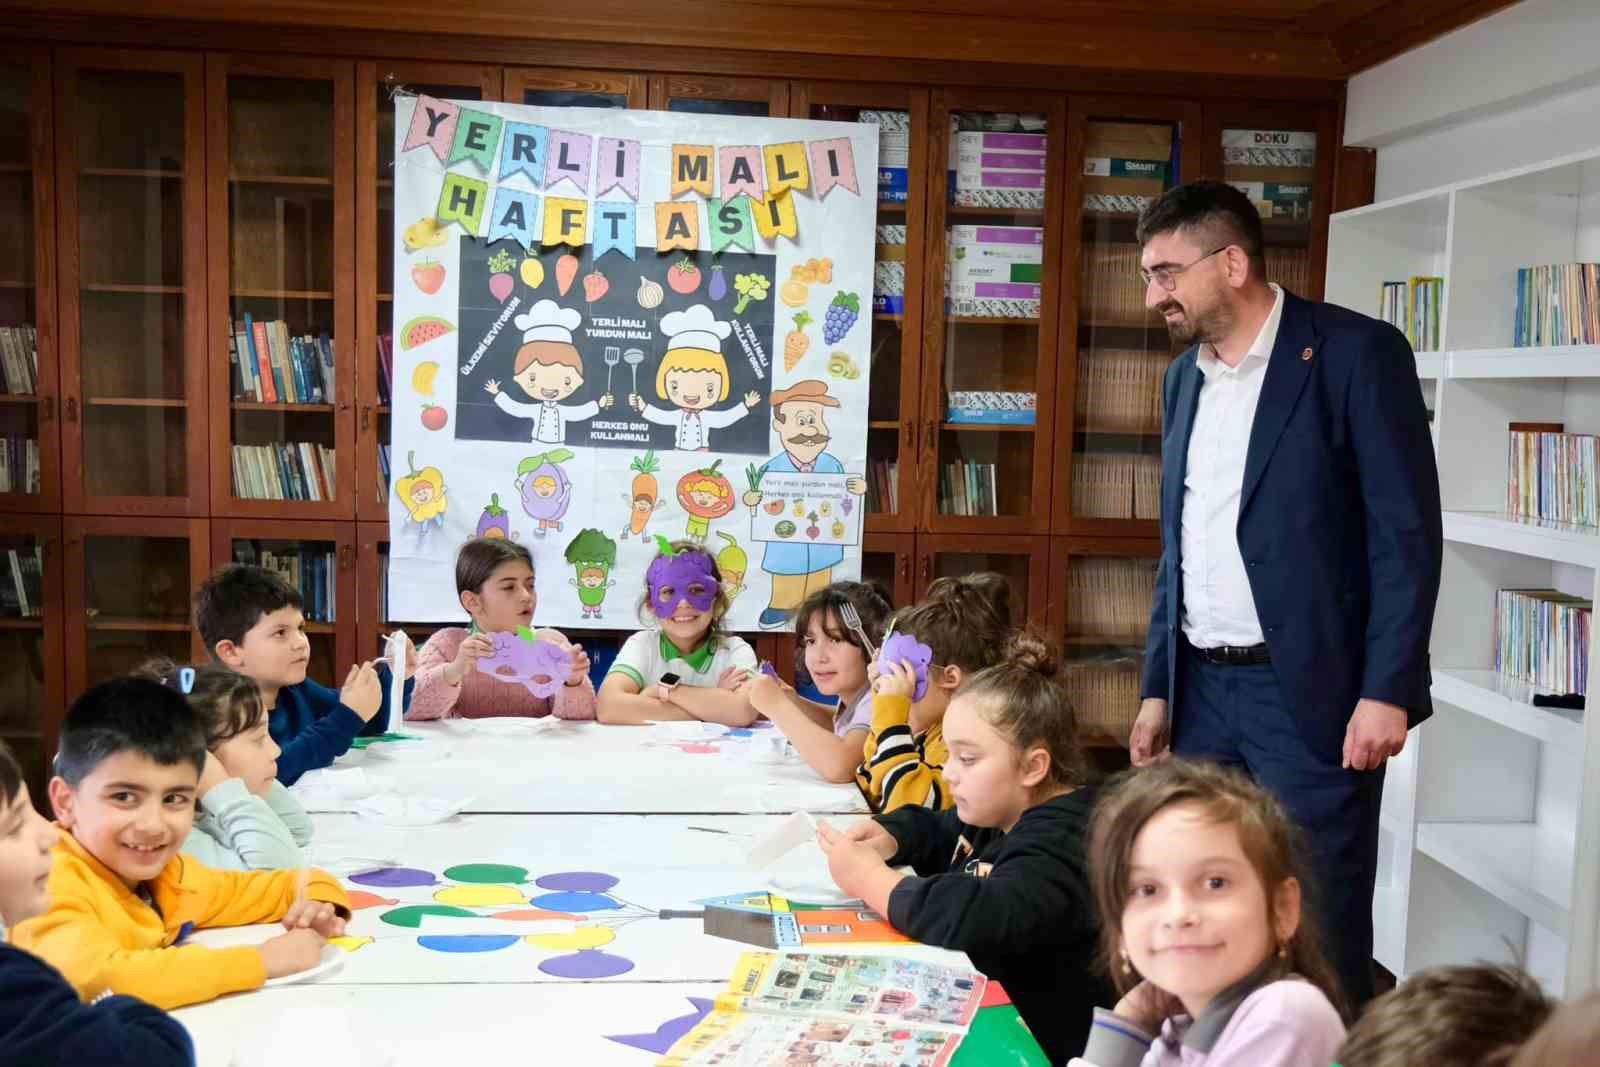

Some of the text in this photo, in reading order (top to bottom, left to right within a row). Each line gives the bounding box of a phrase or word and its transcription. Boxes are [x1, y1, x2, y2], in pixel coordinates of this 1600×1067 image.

[1254, 133, 1290, 144] DOKU
[426, 107, 840, 184] YERLİ MALI
[1125, 161, 1156, 171] SMART
[449, 185, 781, 240] HAFTASI
[592, 316, 647, 328] YERLİ MALI
[627, 331, 652, 340] MALI
[592, 421, 649, 431] HERKES ONU
[590, 431, 650, 442] KULLANMALI
